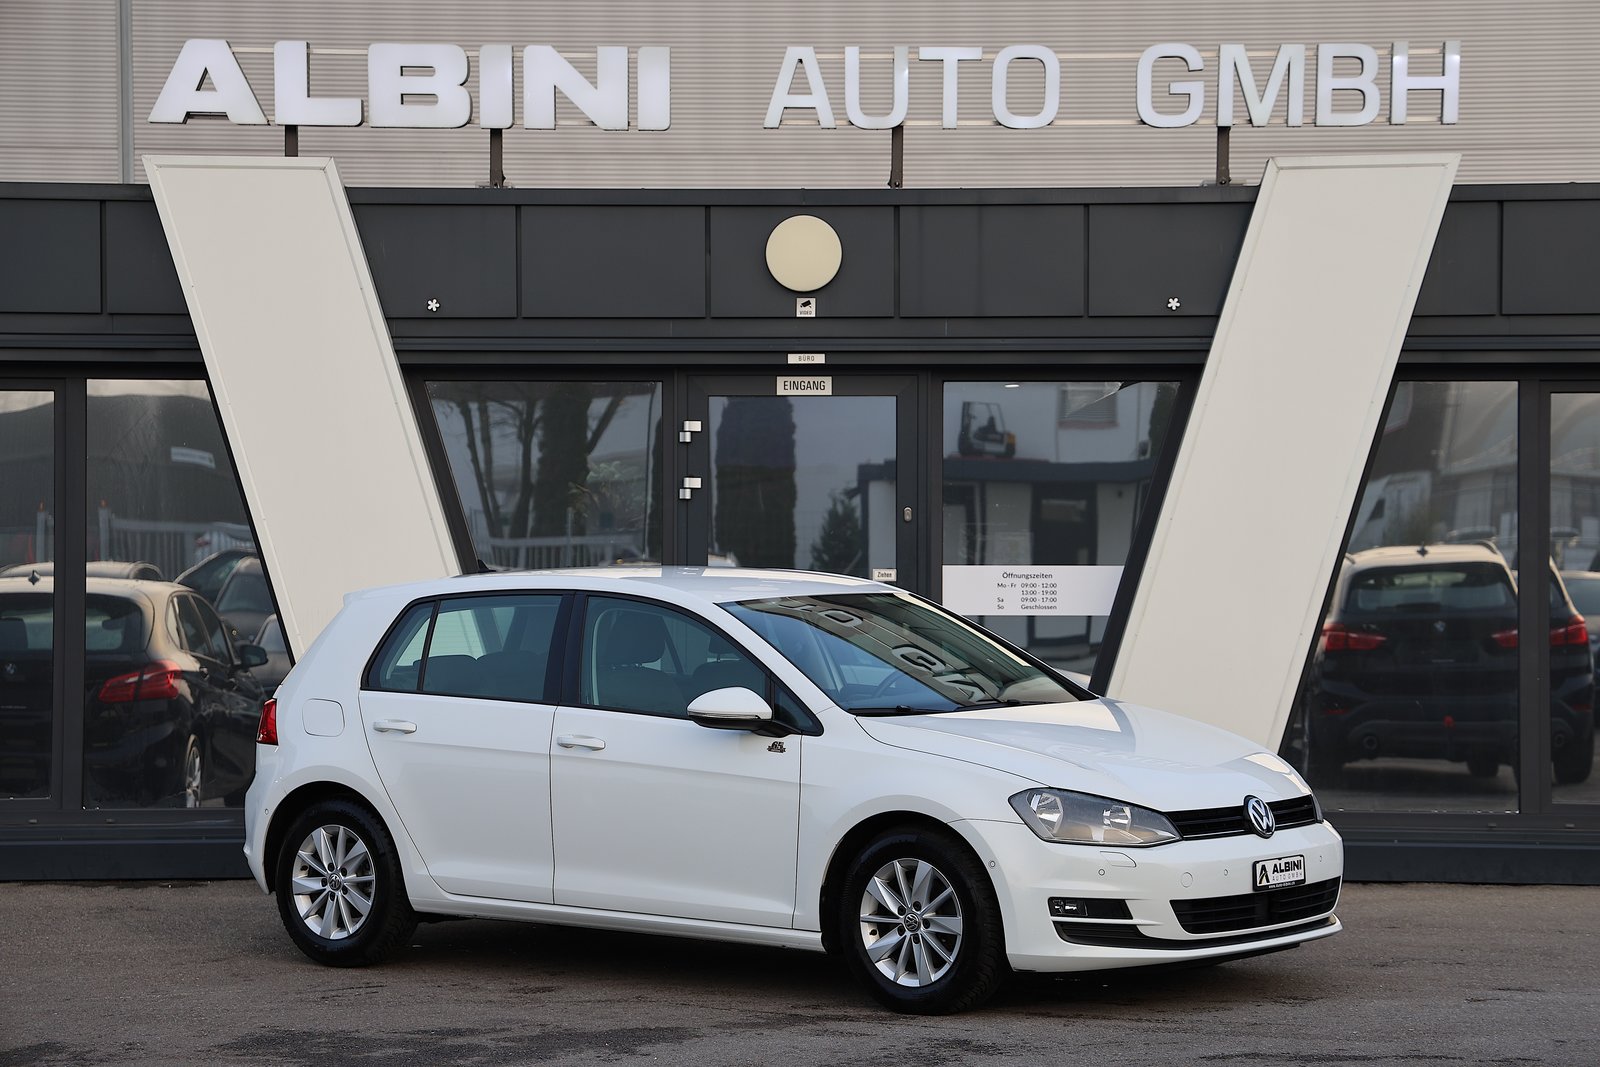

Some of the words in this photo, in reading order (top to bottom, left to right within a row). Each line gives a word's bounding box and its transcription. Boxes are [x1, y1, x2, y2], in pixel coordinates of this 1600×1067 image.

[147, 38, 672, 131] ALBINI
[763, 44, 1061, 130] AUTO
[1136, 40, 1462, 129] GMBH
[798, 354, 815, 362] BÜRO
[783, 380, 826, 391] EINGANG
[1002, 571, 1053, 580] Öffnungszeiten
[1272, 859, 1302, 874] ALBINI
